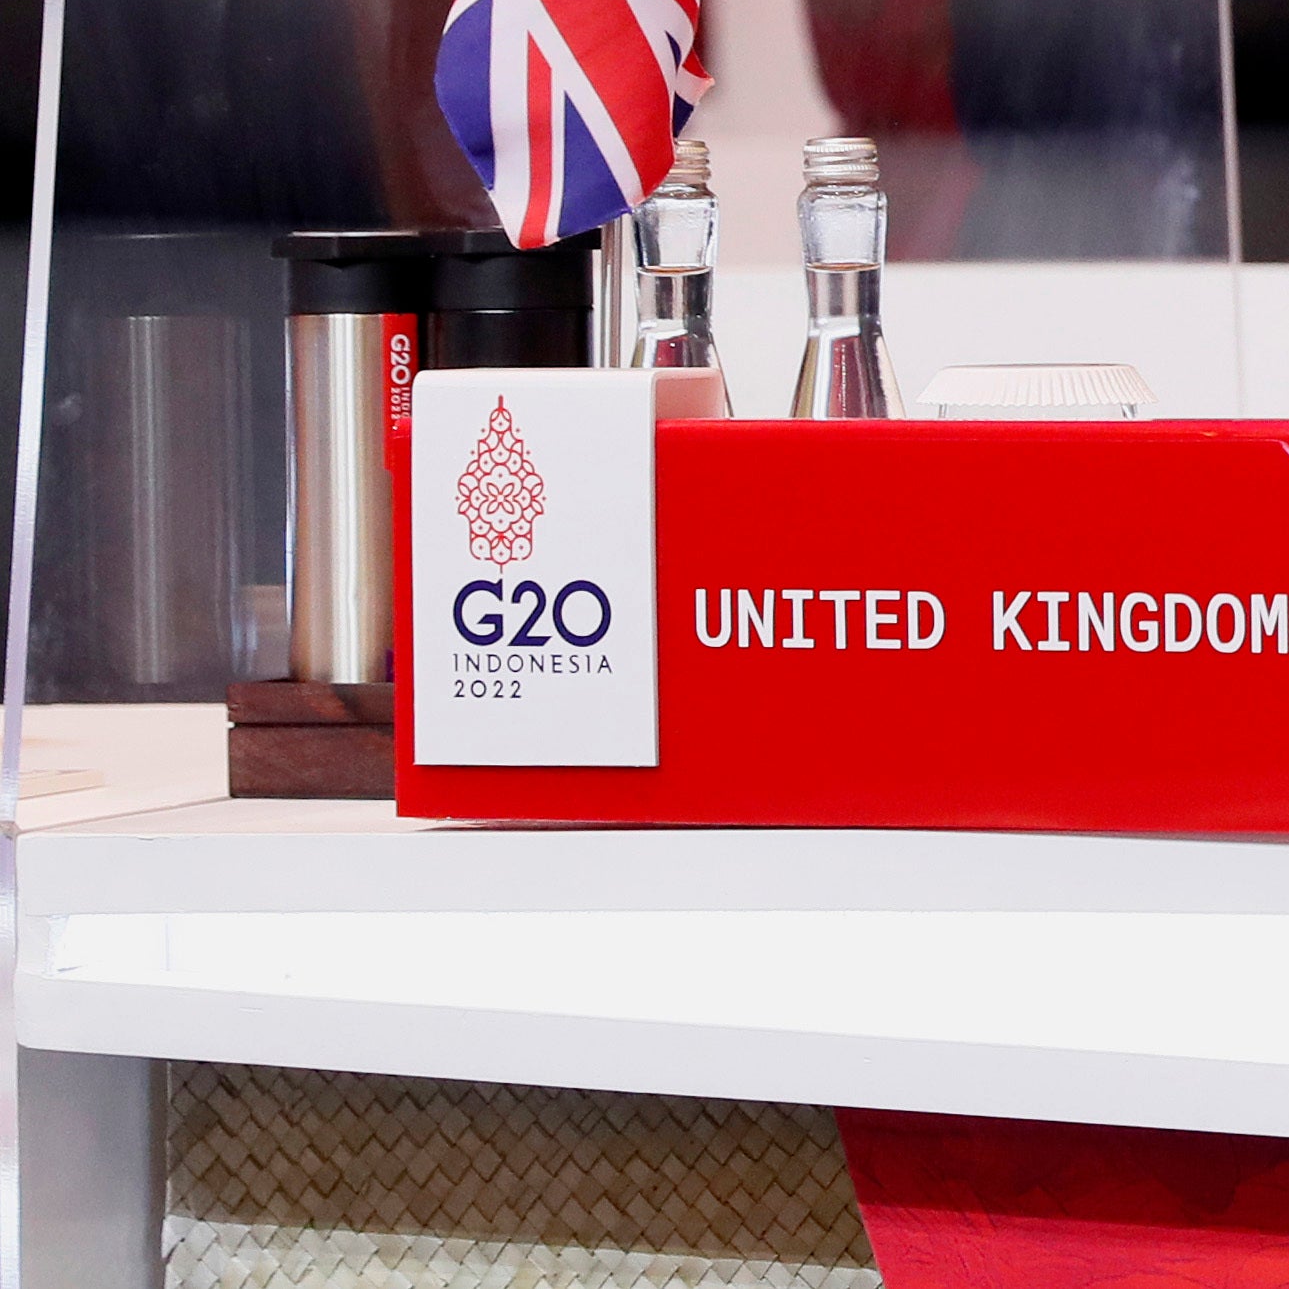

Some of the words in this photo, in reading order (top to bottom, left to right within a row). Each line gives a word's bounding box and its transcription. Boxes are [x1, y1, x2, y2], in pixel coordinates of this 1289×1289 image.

[390, 333, 411, 385] G20
[453, 579, 611, 647] G20
[695, 588, 945, 650] UNITED
[992, 590, 1289, 654] KINGDOM
[453, 653, 613, 674] INDONESIA
[453, 679, 522, 699] 2022
